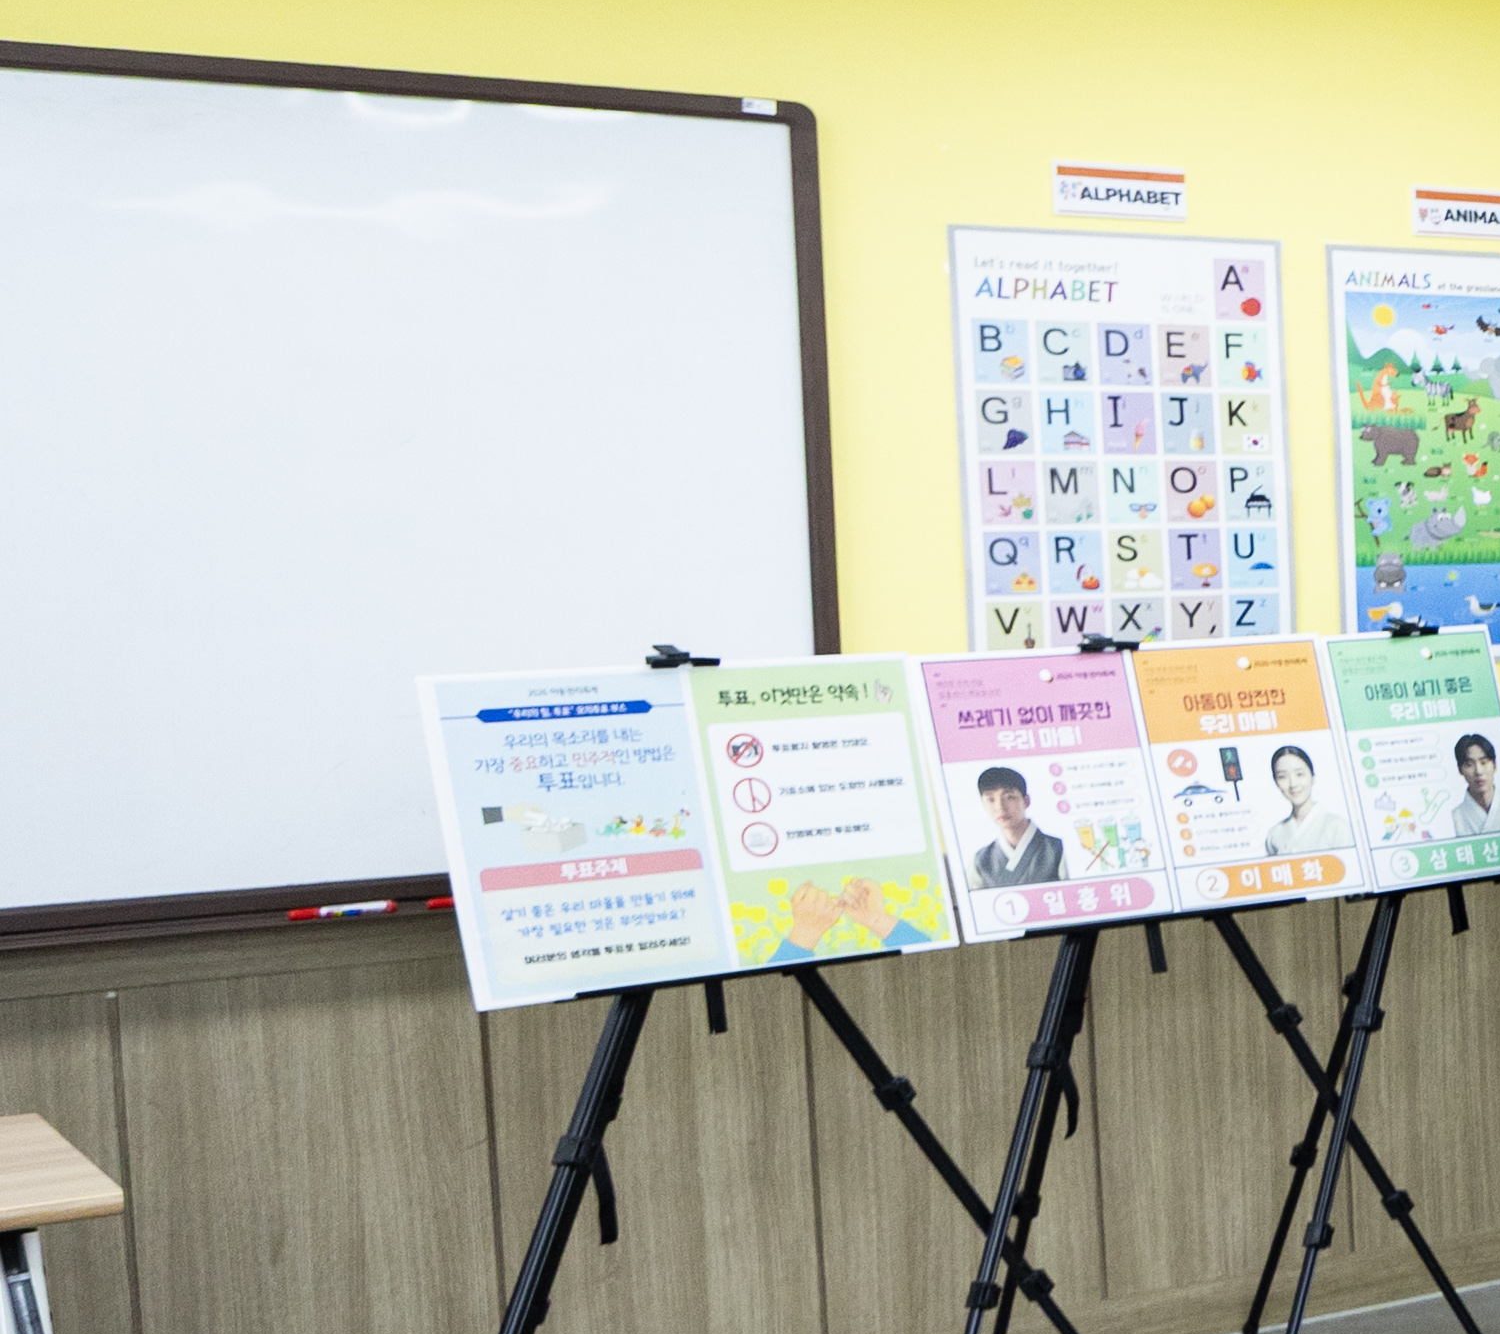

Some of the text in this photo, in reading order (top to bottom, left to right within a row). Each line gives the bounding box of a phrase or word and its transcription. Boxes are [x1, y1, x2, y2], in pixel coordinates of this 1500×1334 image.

[1080, 186, 1182, 206] ALPHABET
[975, 276, 1119, 303] ALPHABET
[1221, 264, 1244, 292] A
[1345, 270, 1432, 289] ANIMALS
[1449, 282, 1464, 292] the
[980, 324, 1002, 352] B
[1043, 328, 1069, 356] C
[1105, 329, 1129, 357] D
[1166, 331, 1186, 358] E
[1224, 333, 1243, 359] F
[981, 396, 1008, 425] G
[1046, 398, 1070, 425] H
[1107, 395, 1124, 428] I
[1169, 396, 1188, 427] J
[1228, 400, 1247, 427] K
[987, 467, 1008, 495] L
[1050, 467, 1078, 495] M
[1113, 467, 1135, 494] N
[1170, 466, 1197, 494] O
[1229, 467, 1248, 493] P
[989, 537, 1018, 566] Q
[1054, 536, 1075, 564] R
[1116, 534, 1138, 562] S
[1177, 533, 1198, 561] T
[1233, 533, 1255, 559] U
[994, 607, 1020, 635] V
[1056, 605, 1088, 634] W
[1119, 603, 1142, 631] X
[1179, 601, 1202, 628] Y
[1236, 600, 1256, 627] Z
[717, 690, 756, 707] 투표,
[760, 683, 825, 706] 이것만은
[1183, 687, 1286, 713] 아동이 안전한
[1364, 675, 1473, 702] 아동이 살기 좋은
[958, 700, 1112, 729] 쓰레기 없이 깨끗한
[1199, 709, 1279, 736] 우리 마을!
[1389, 697, 1458, 722] 우리 마을!
[502, 727, 644, 750] 우리의 목소리를 내는
[996, 725, 1083, 751] 우리 마을!
[474, 744, 676, 775] 가장 중요하고 민주적인 방법은
[537, 771, 625, 793] 투표입니다.
[561, 856, 629, 881] 투표주제
[1400, 855, 1412, 873] 3
[1204, 874, 1220, 893] 2
[560, 899, 585, 915] 우리
